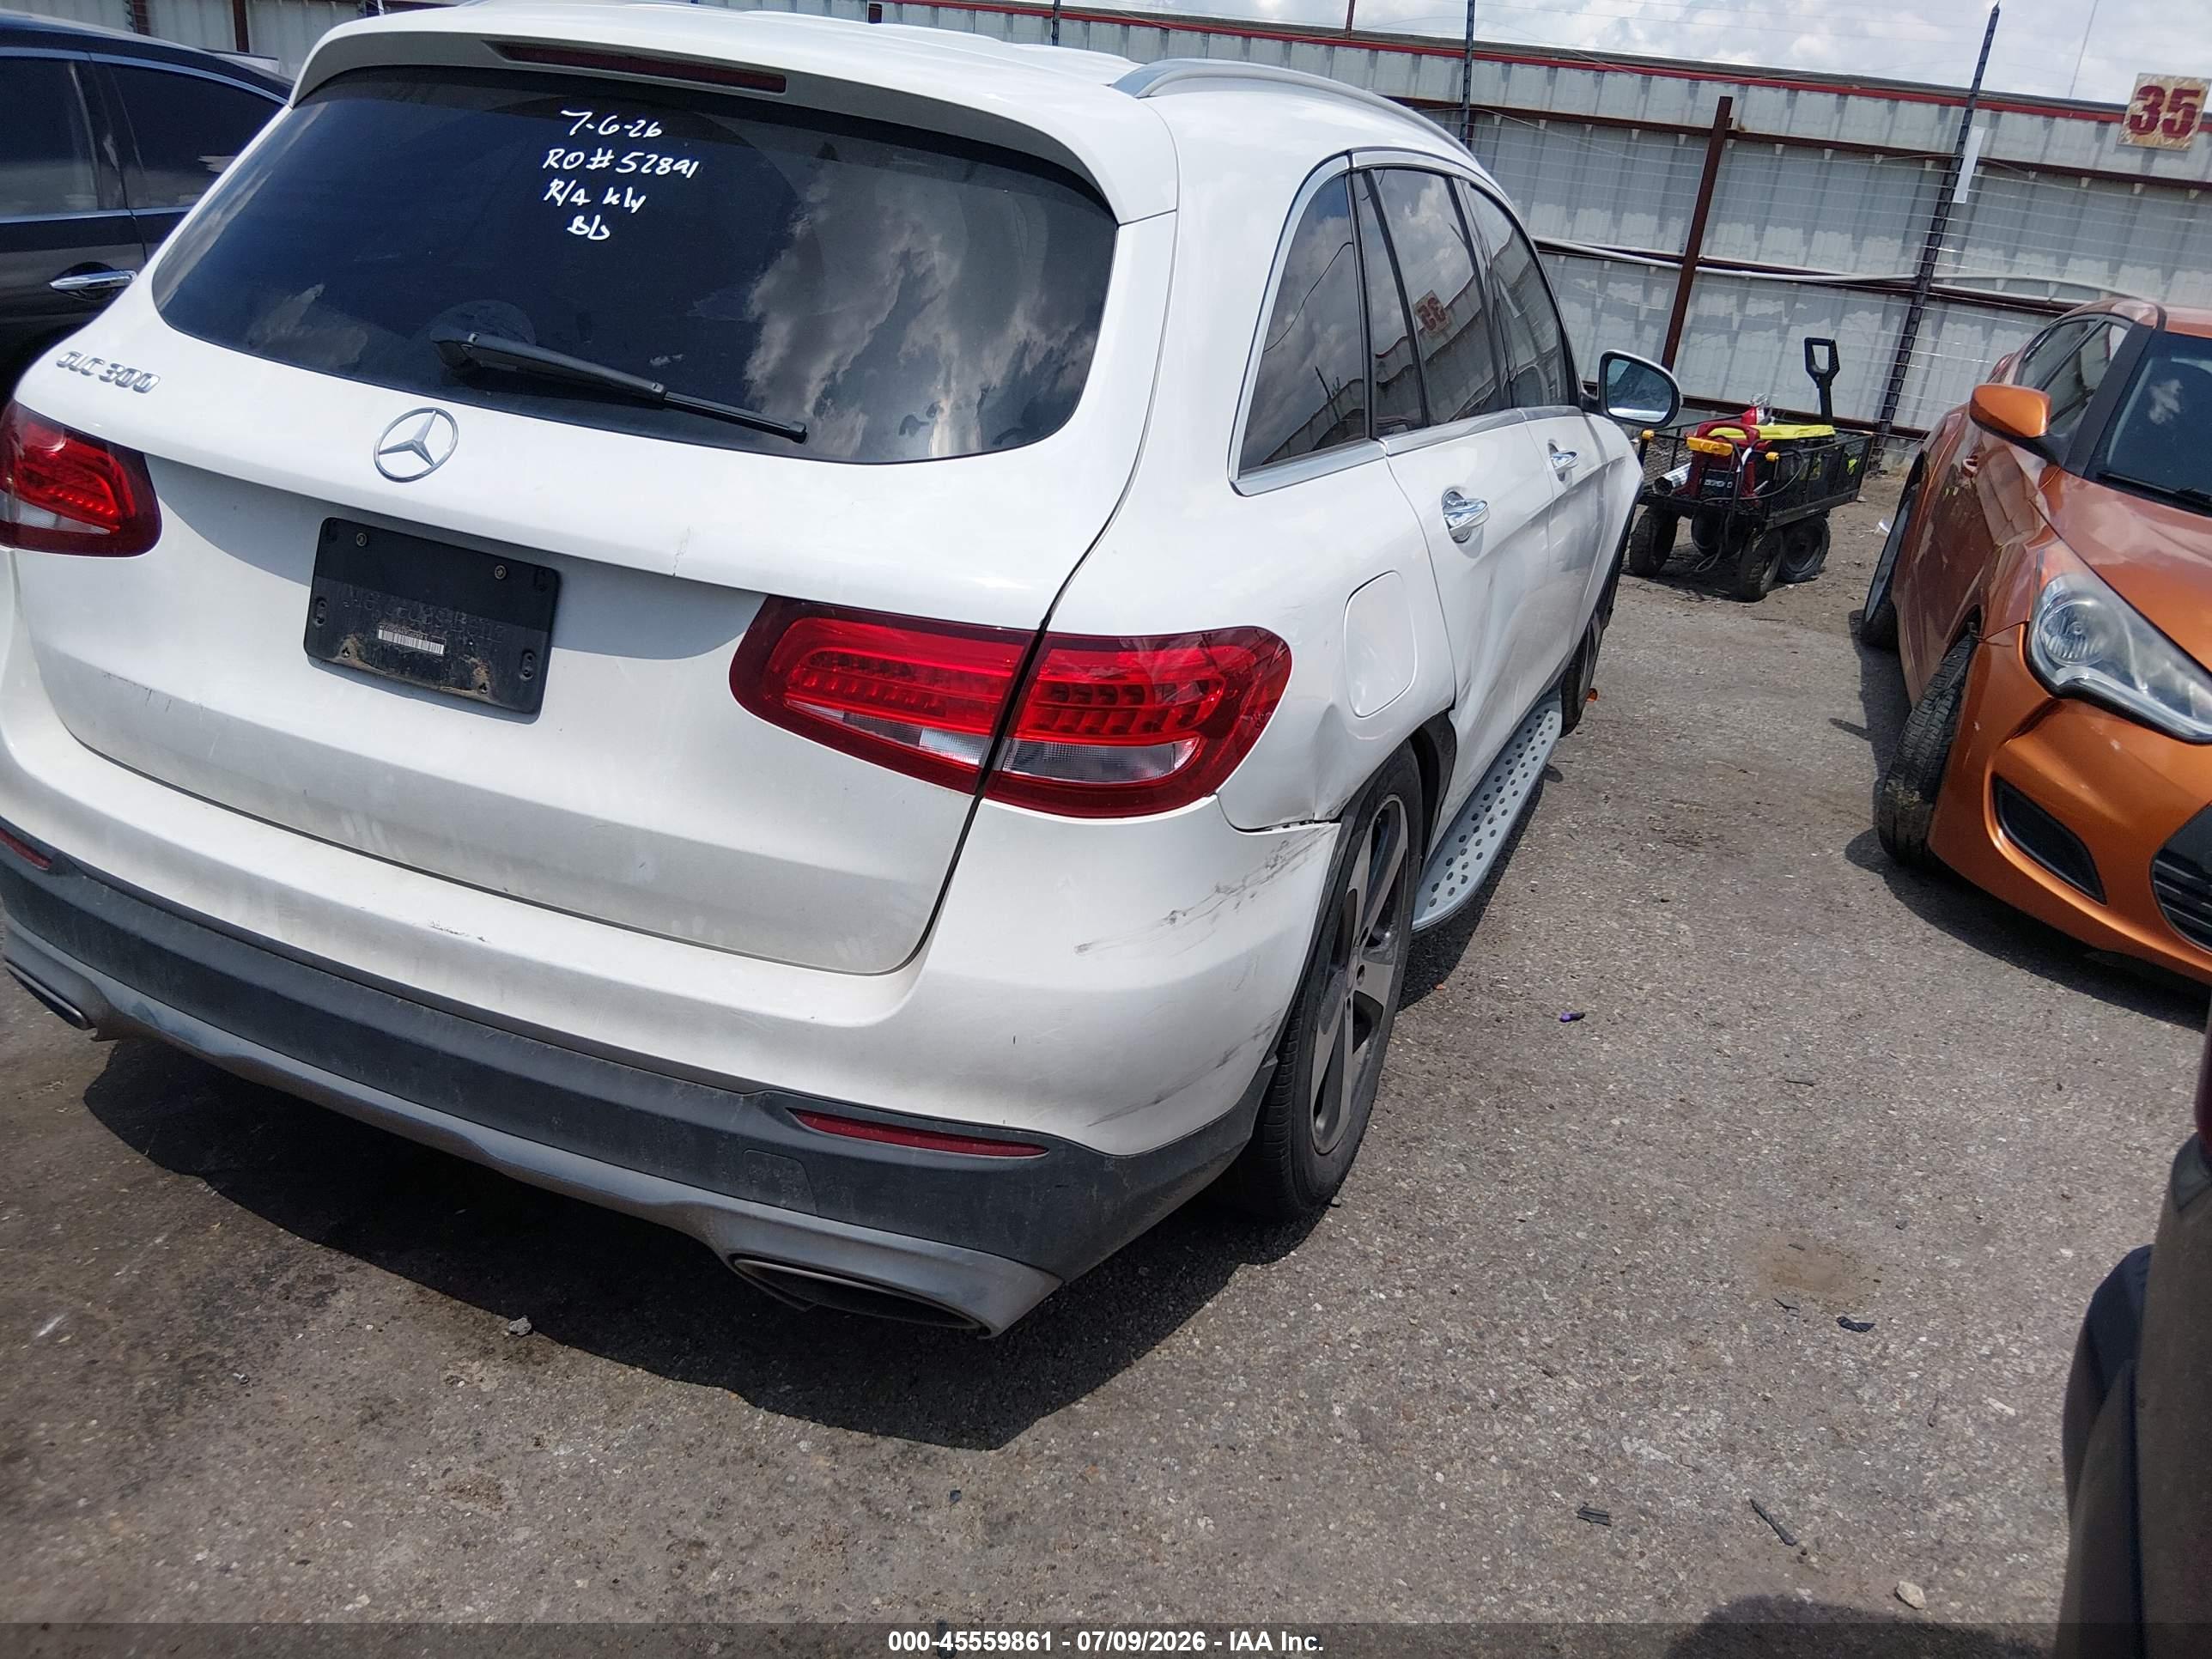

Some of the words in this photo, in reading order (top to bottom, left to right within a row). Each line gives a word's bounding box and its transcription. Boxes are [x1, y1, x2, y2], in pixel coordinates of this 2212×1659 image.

[560, 110, 664, 138] 7-6-26
[2129, 85, 2201, 139] 35
[56, 350, 105, 376] GLC
[99, 362, 161, 394] 300
